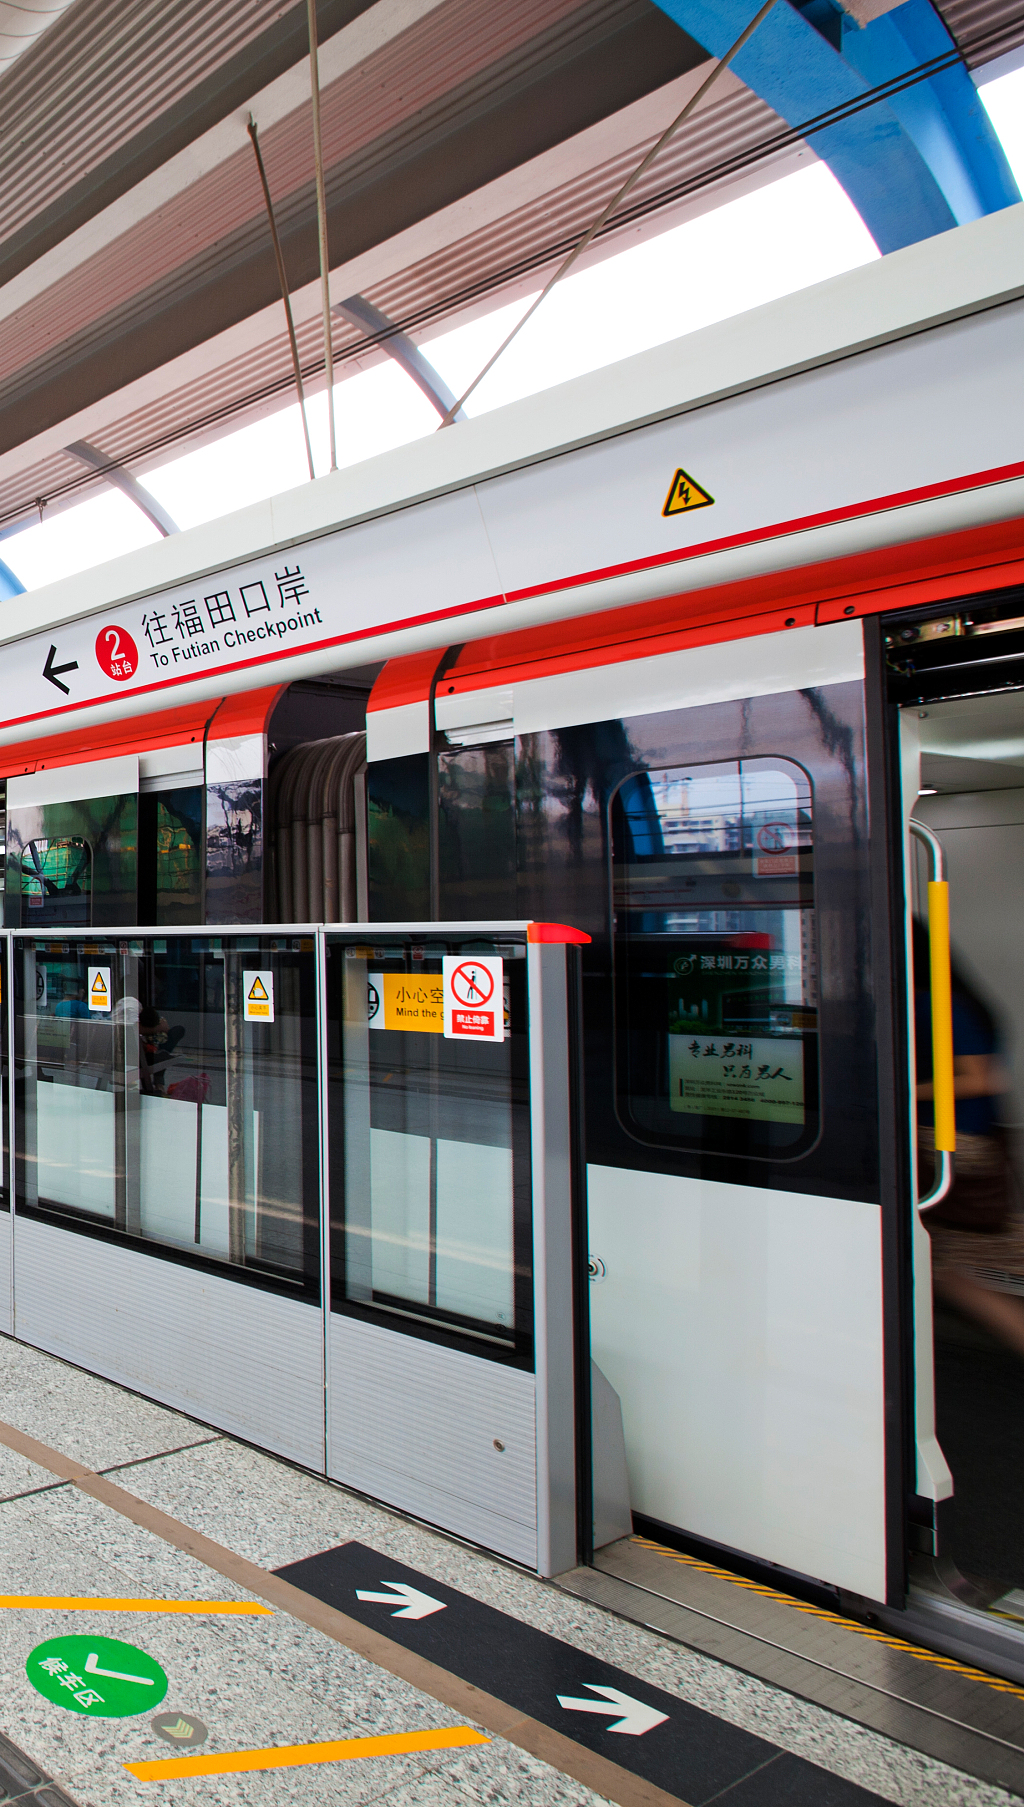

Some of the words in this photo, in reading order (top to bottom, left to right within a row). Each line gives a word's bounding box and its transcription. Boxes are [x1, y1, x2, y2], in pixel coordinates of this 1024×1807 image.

[141, 565, 310, 648] 往福田口岸
[104, 629, 126, 661] 2
[149, 652, 170, 668] To
[171, 639, 221, 663] Futian
[223, 607, 323, 648] Checkpoint
[110, 659, 133, 677] 站台
[700, 954, 801, 970] 深圳万众男科
[396, 1007, 419, 1017] Mind
[422, 1008, 437, 1018] the
[687, 1039, 753, 1060] 专业男科
[38, 1657, 106, 1709] 候车区
